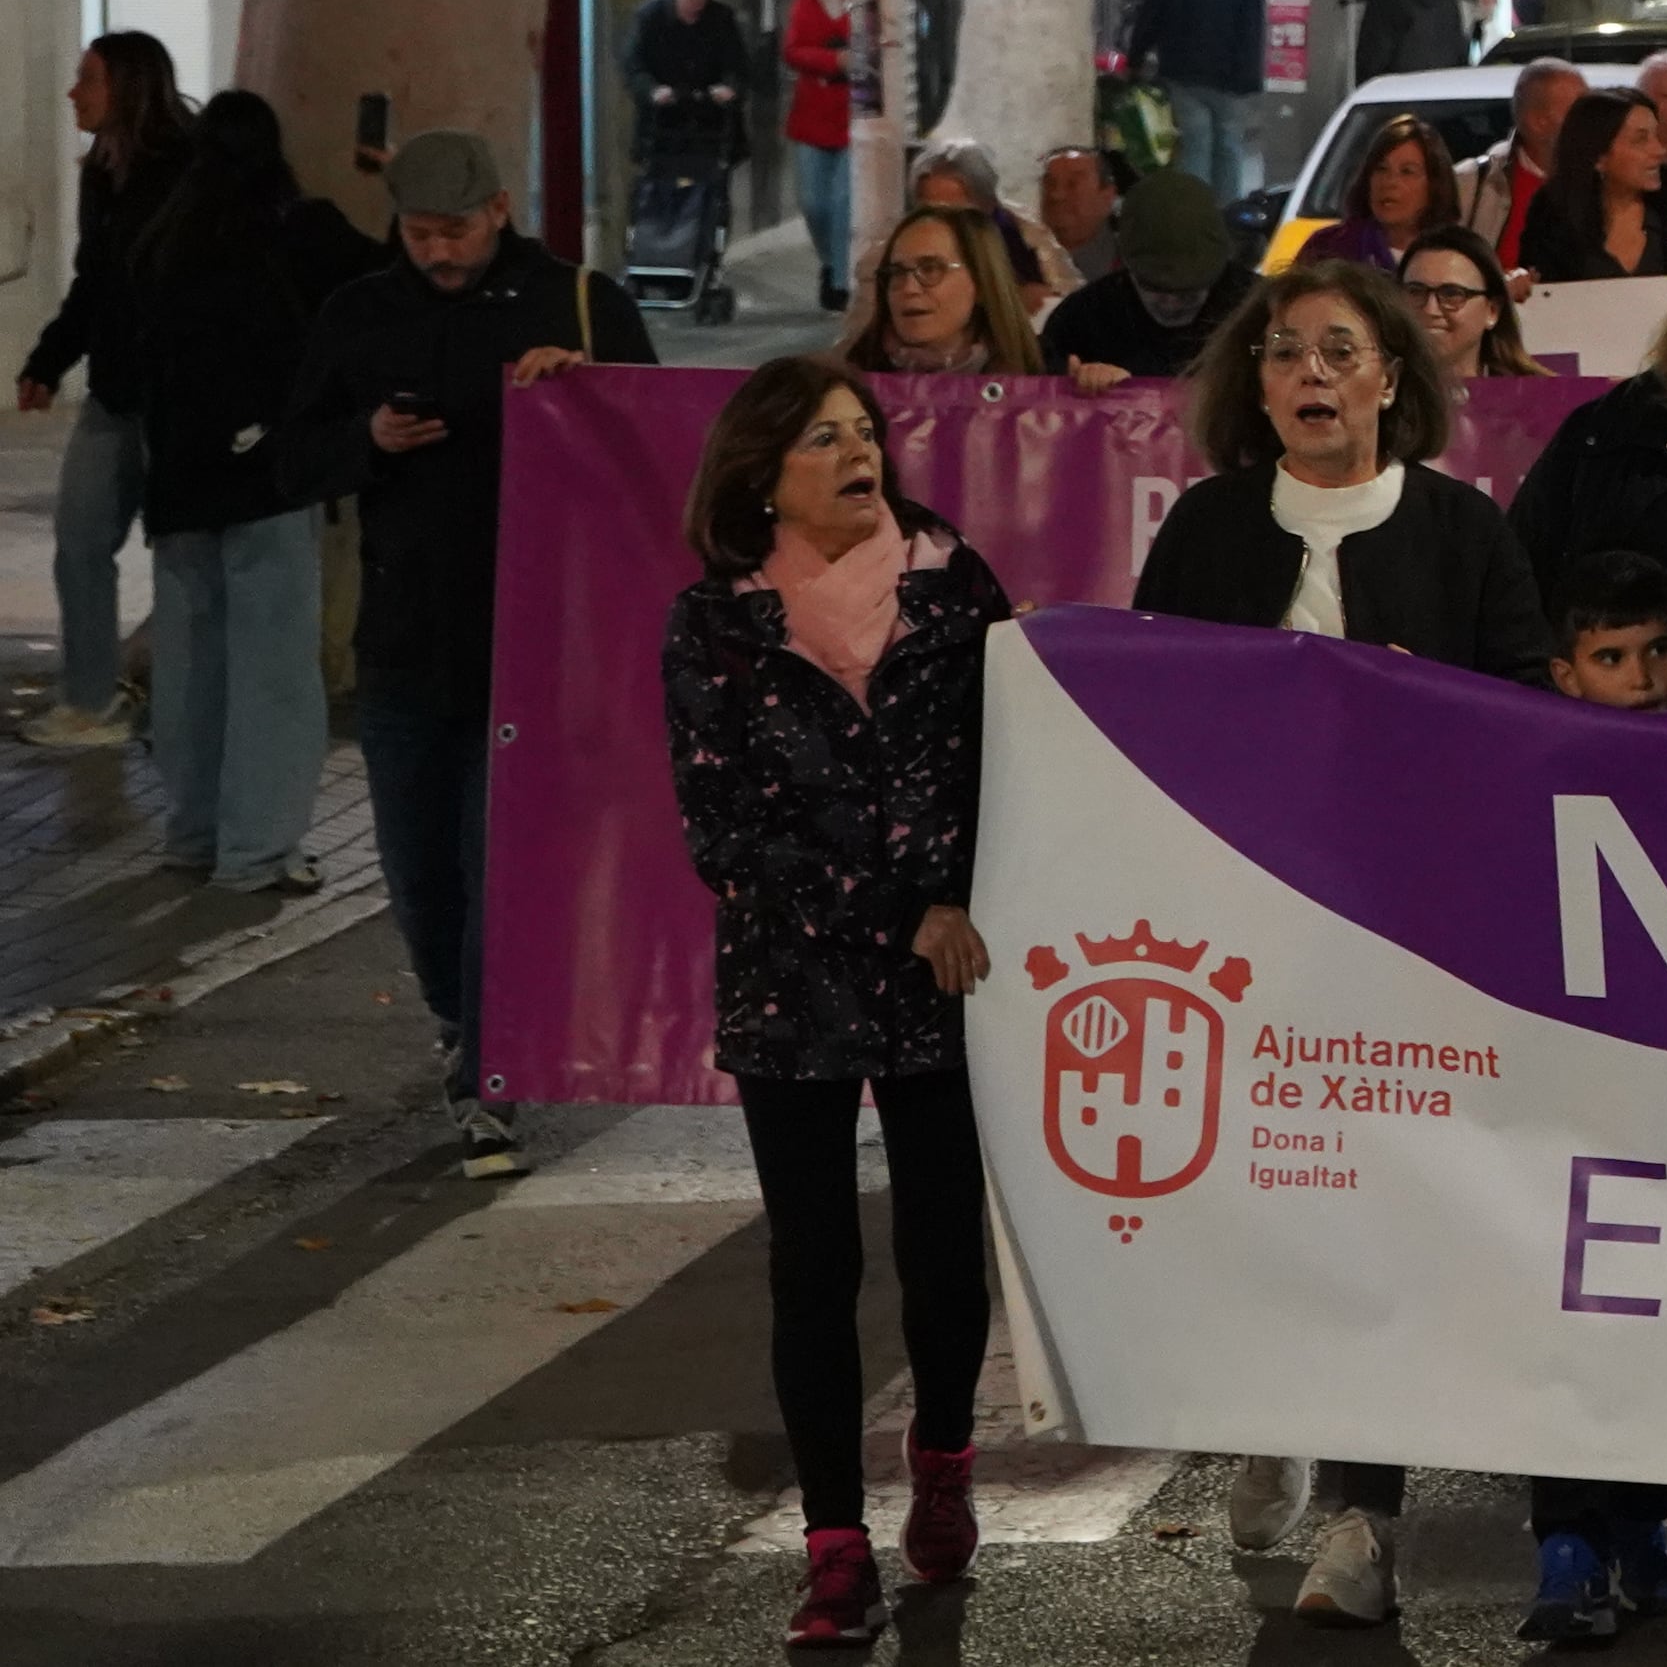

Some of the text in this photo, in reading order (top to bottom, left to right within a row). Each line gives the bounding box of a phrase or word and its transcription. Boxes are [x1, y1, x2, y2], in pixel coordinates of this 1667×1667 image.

[1252, 1024, 1501, 1079] Ajuntament
[1250, 1072, 1452, 1117] de Xàtiva
[1252, 1126, 1344, 1153] Dona i
[1249, 1161, 1358, 1190] Igualtat
